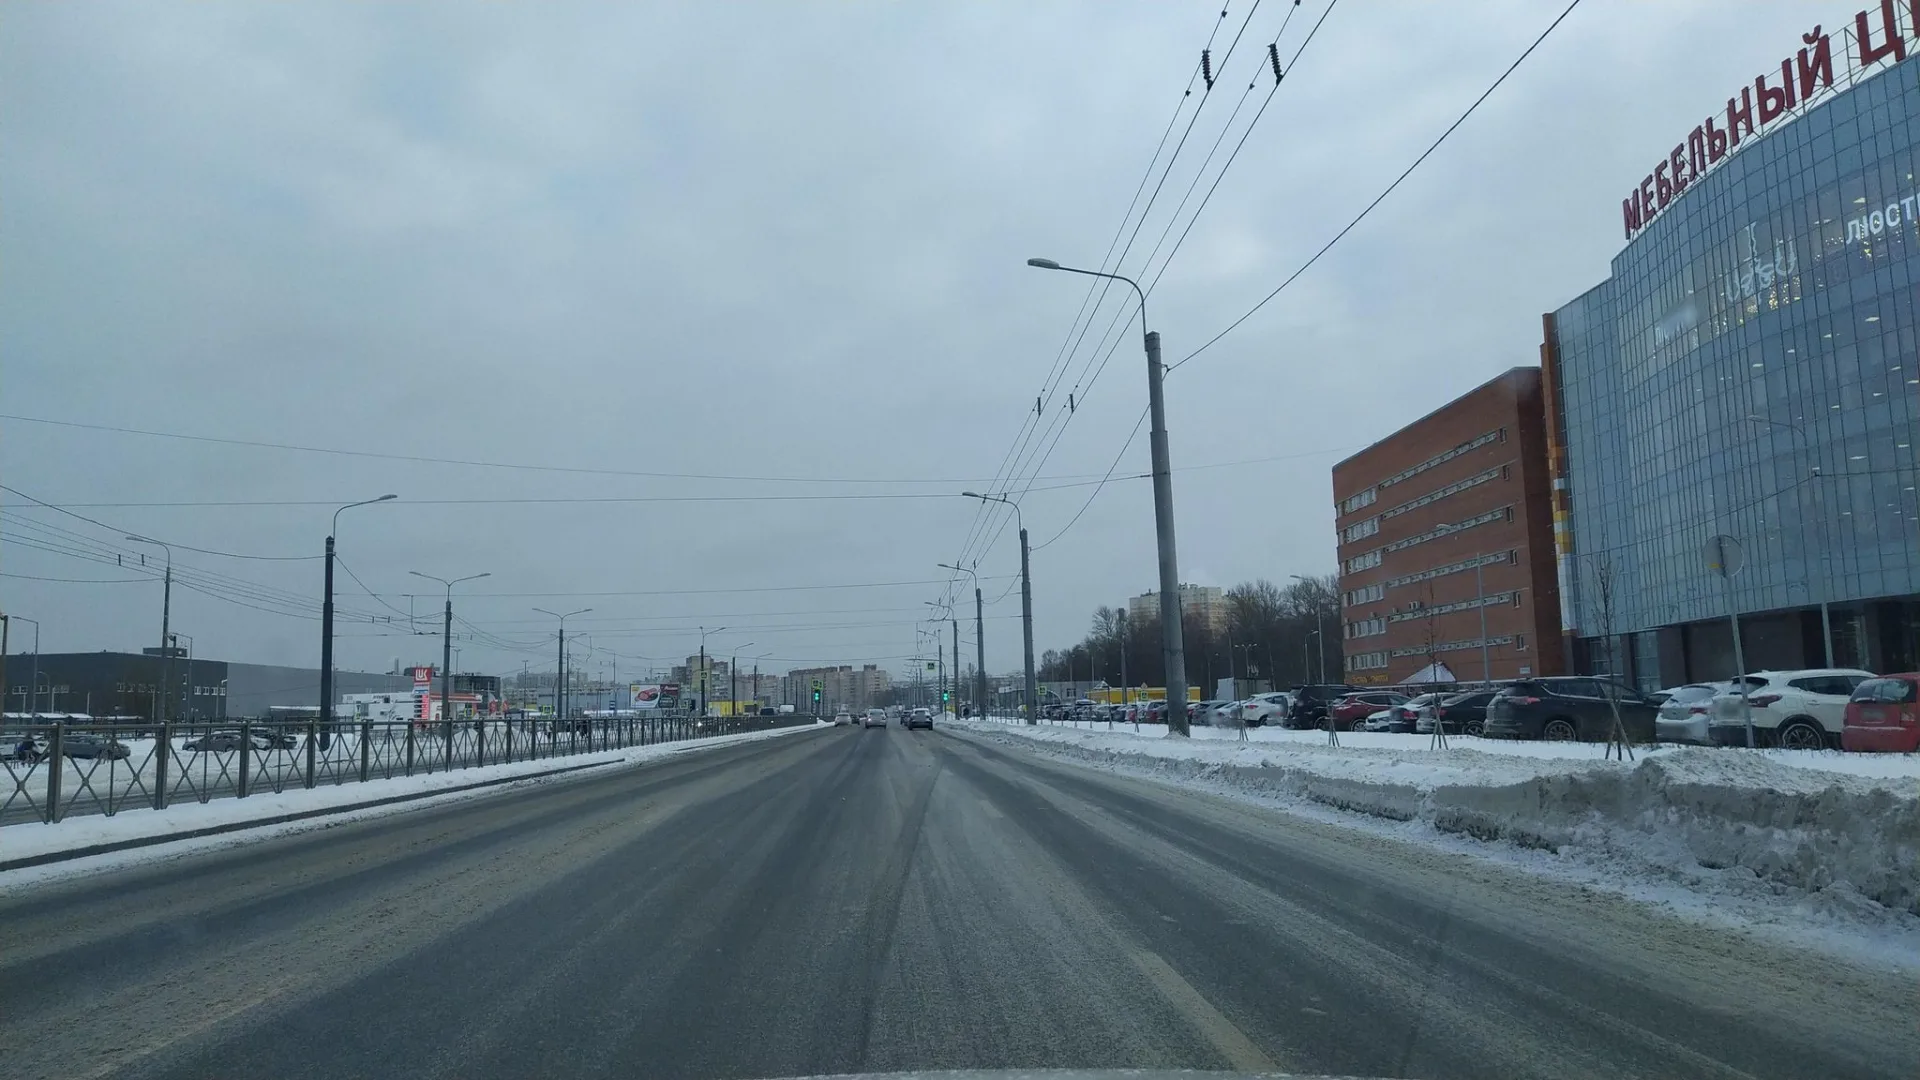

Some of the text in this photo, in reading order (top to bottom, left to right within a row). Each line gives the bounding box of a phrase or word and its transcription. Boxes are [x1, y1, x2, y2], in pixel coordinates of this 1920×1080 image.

[1622, 0, 1920, 240] МЕБЕЛЬНЫЙ Ц
[1845, 191, 1920, 245] ЛЮСТ
